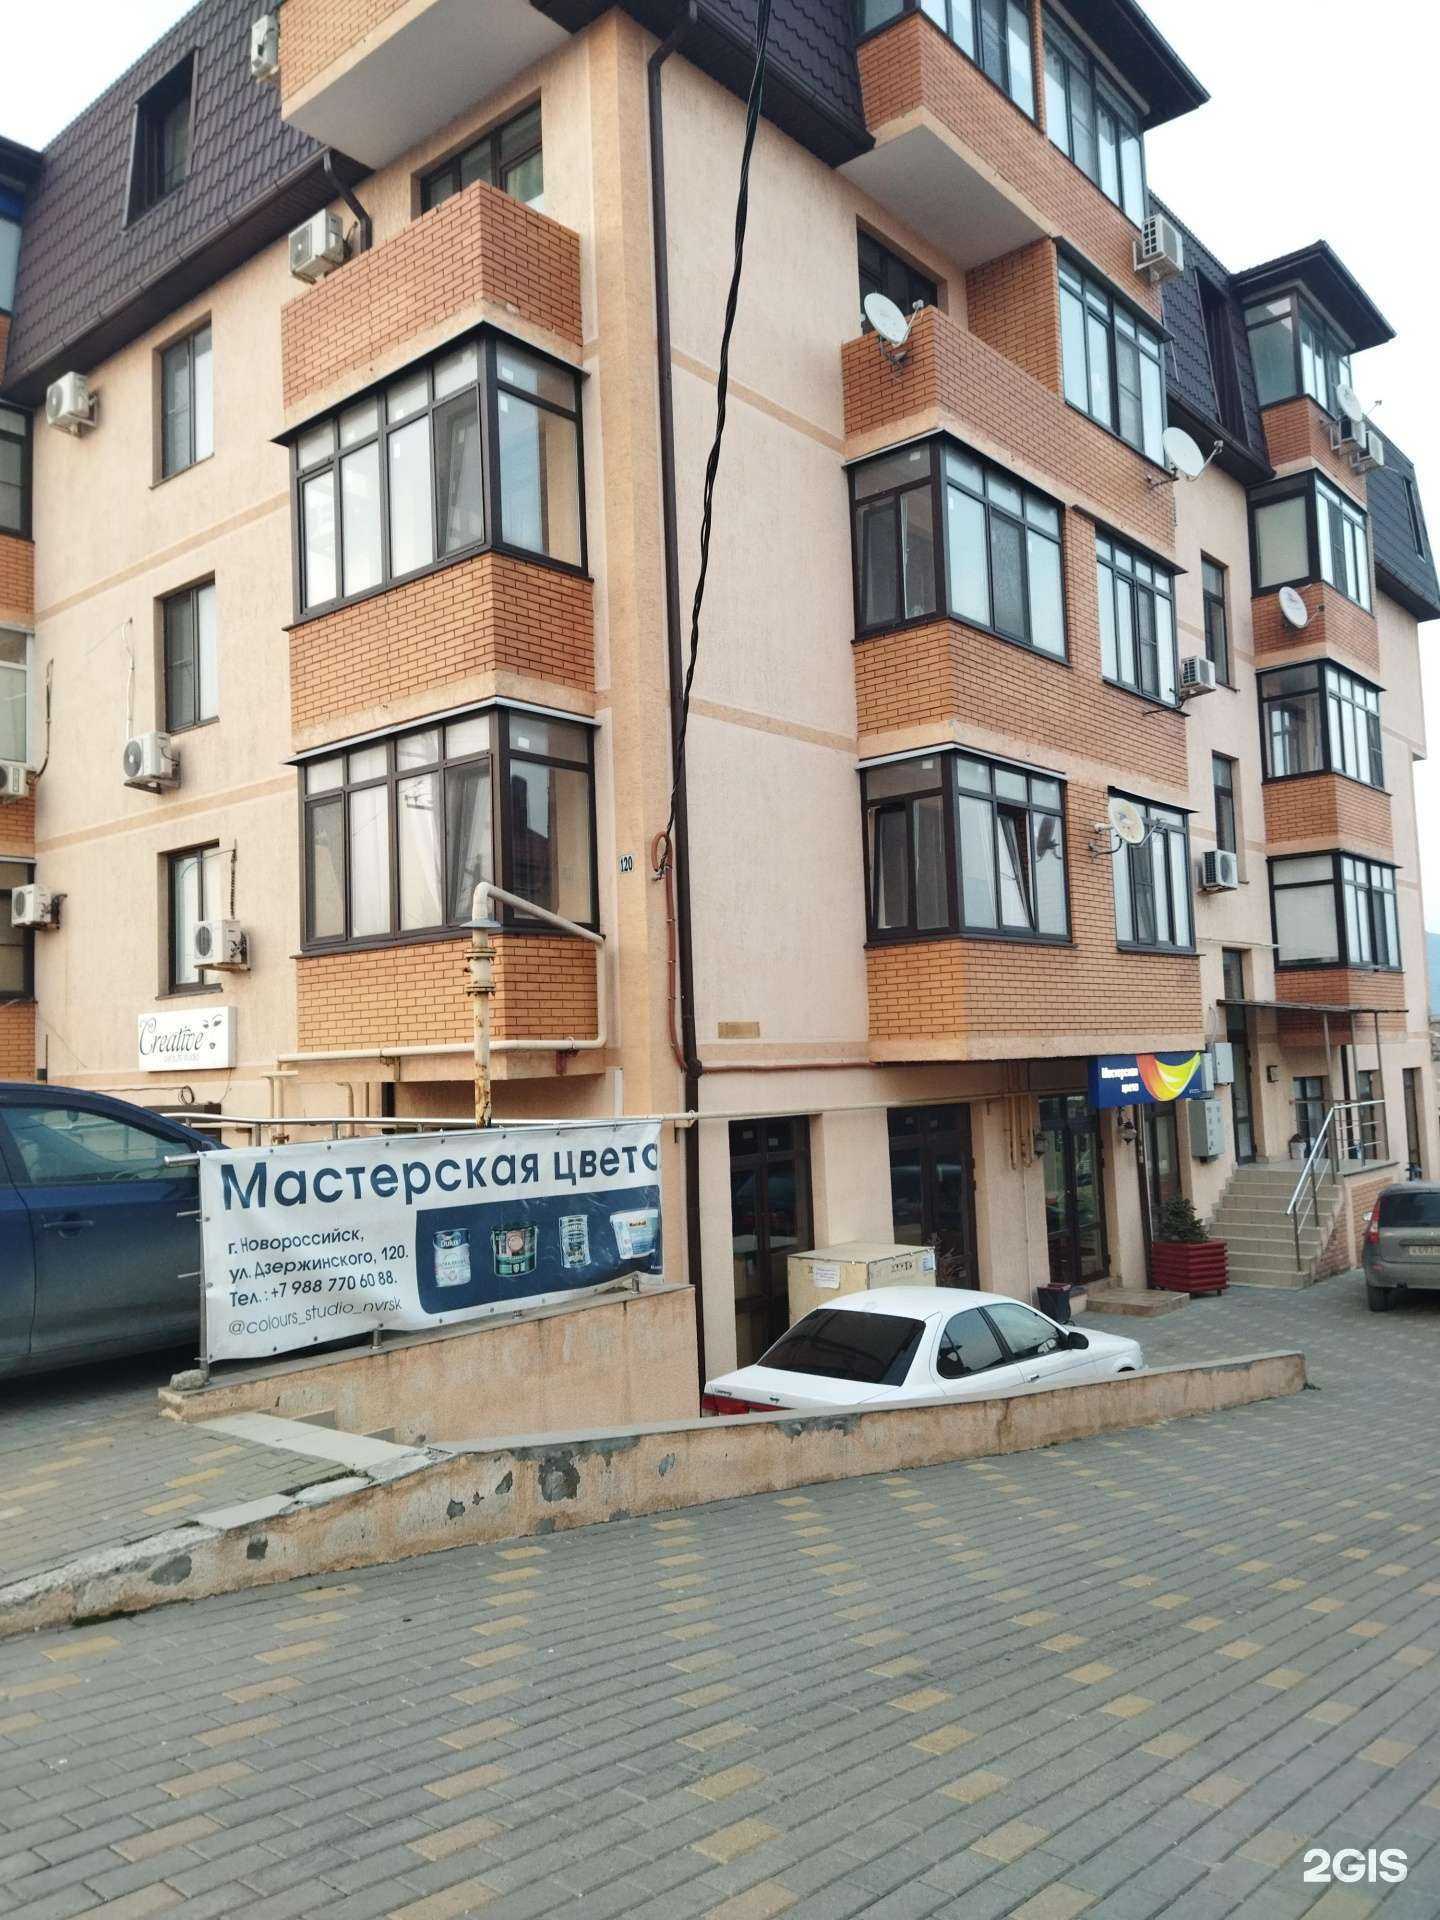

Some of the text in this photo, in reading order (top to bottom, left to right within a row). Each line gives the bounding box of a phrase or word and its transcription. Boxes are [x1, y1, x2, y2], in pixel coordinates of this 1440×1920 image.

[620, 855, 633, 872] 120
[139, 1017, 204, 1056] Creative
[220, 1152, 540, 1211] Мастерская
[240, 1227, 364, 1253] Новороссийск,
[229, 1244, 409, 1284] ул. Дзержинского, 120.
[291, 1279, 322, 1295] 988
[328, 1275, 356, 1292] 770
[360, 1272, 376, 1289] 60
[378, 1270, 398, 1286] 88.
